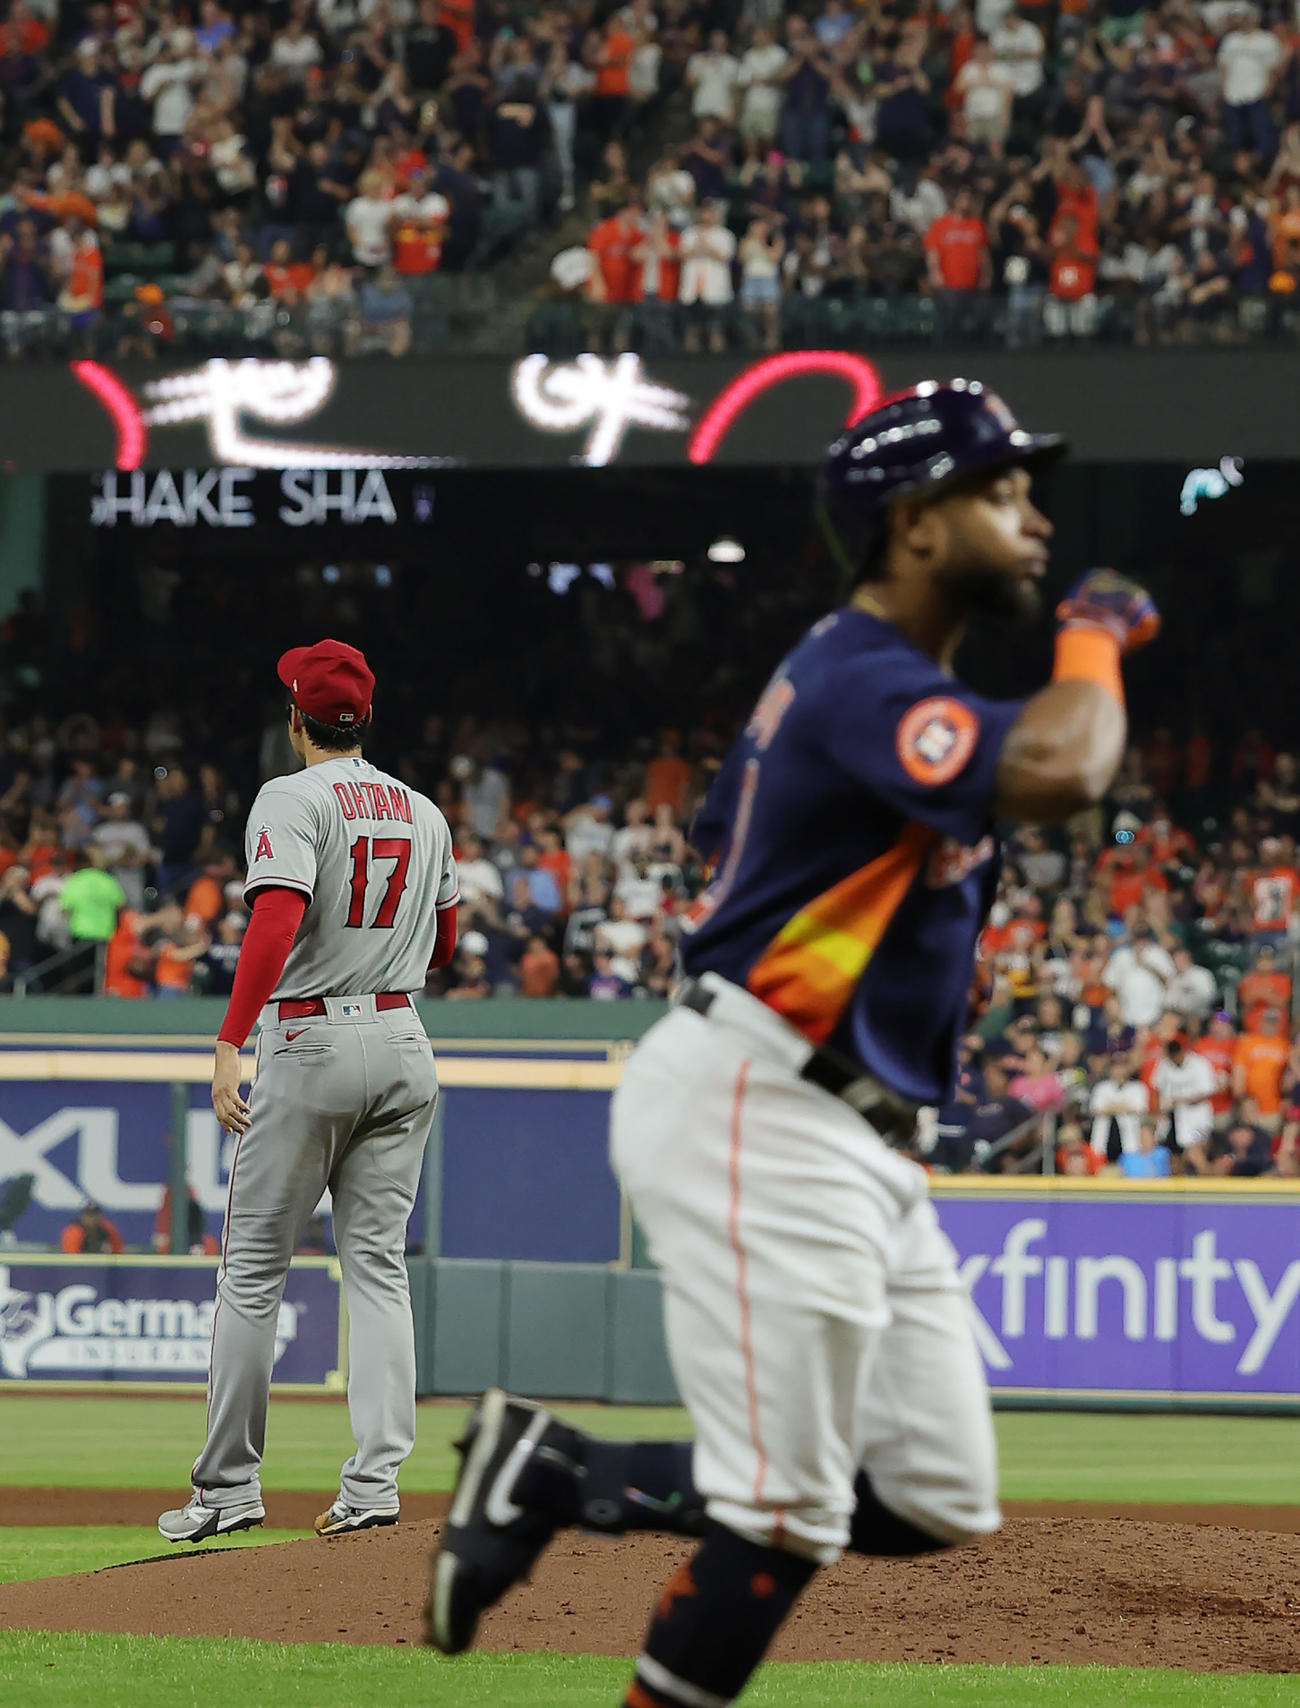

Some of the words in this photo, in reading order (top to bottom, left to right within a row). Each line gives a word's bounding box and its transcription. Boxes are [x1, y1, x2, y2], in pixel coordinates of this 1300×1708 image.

[280, 468, 397, 526] SHA
[333, 782, 413, 824] OHTANI
[255, 827, 275, 862] A
[344, 836, 411, 928] 17
